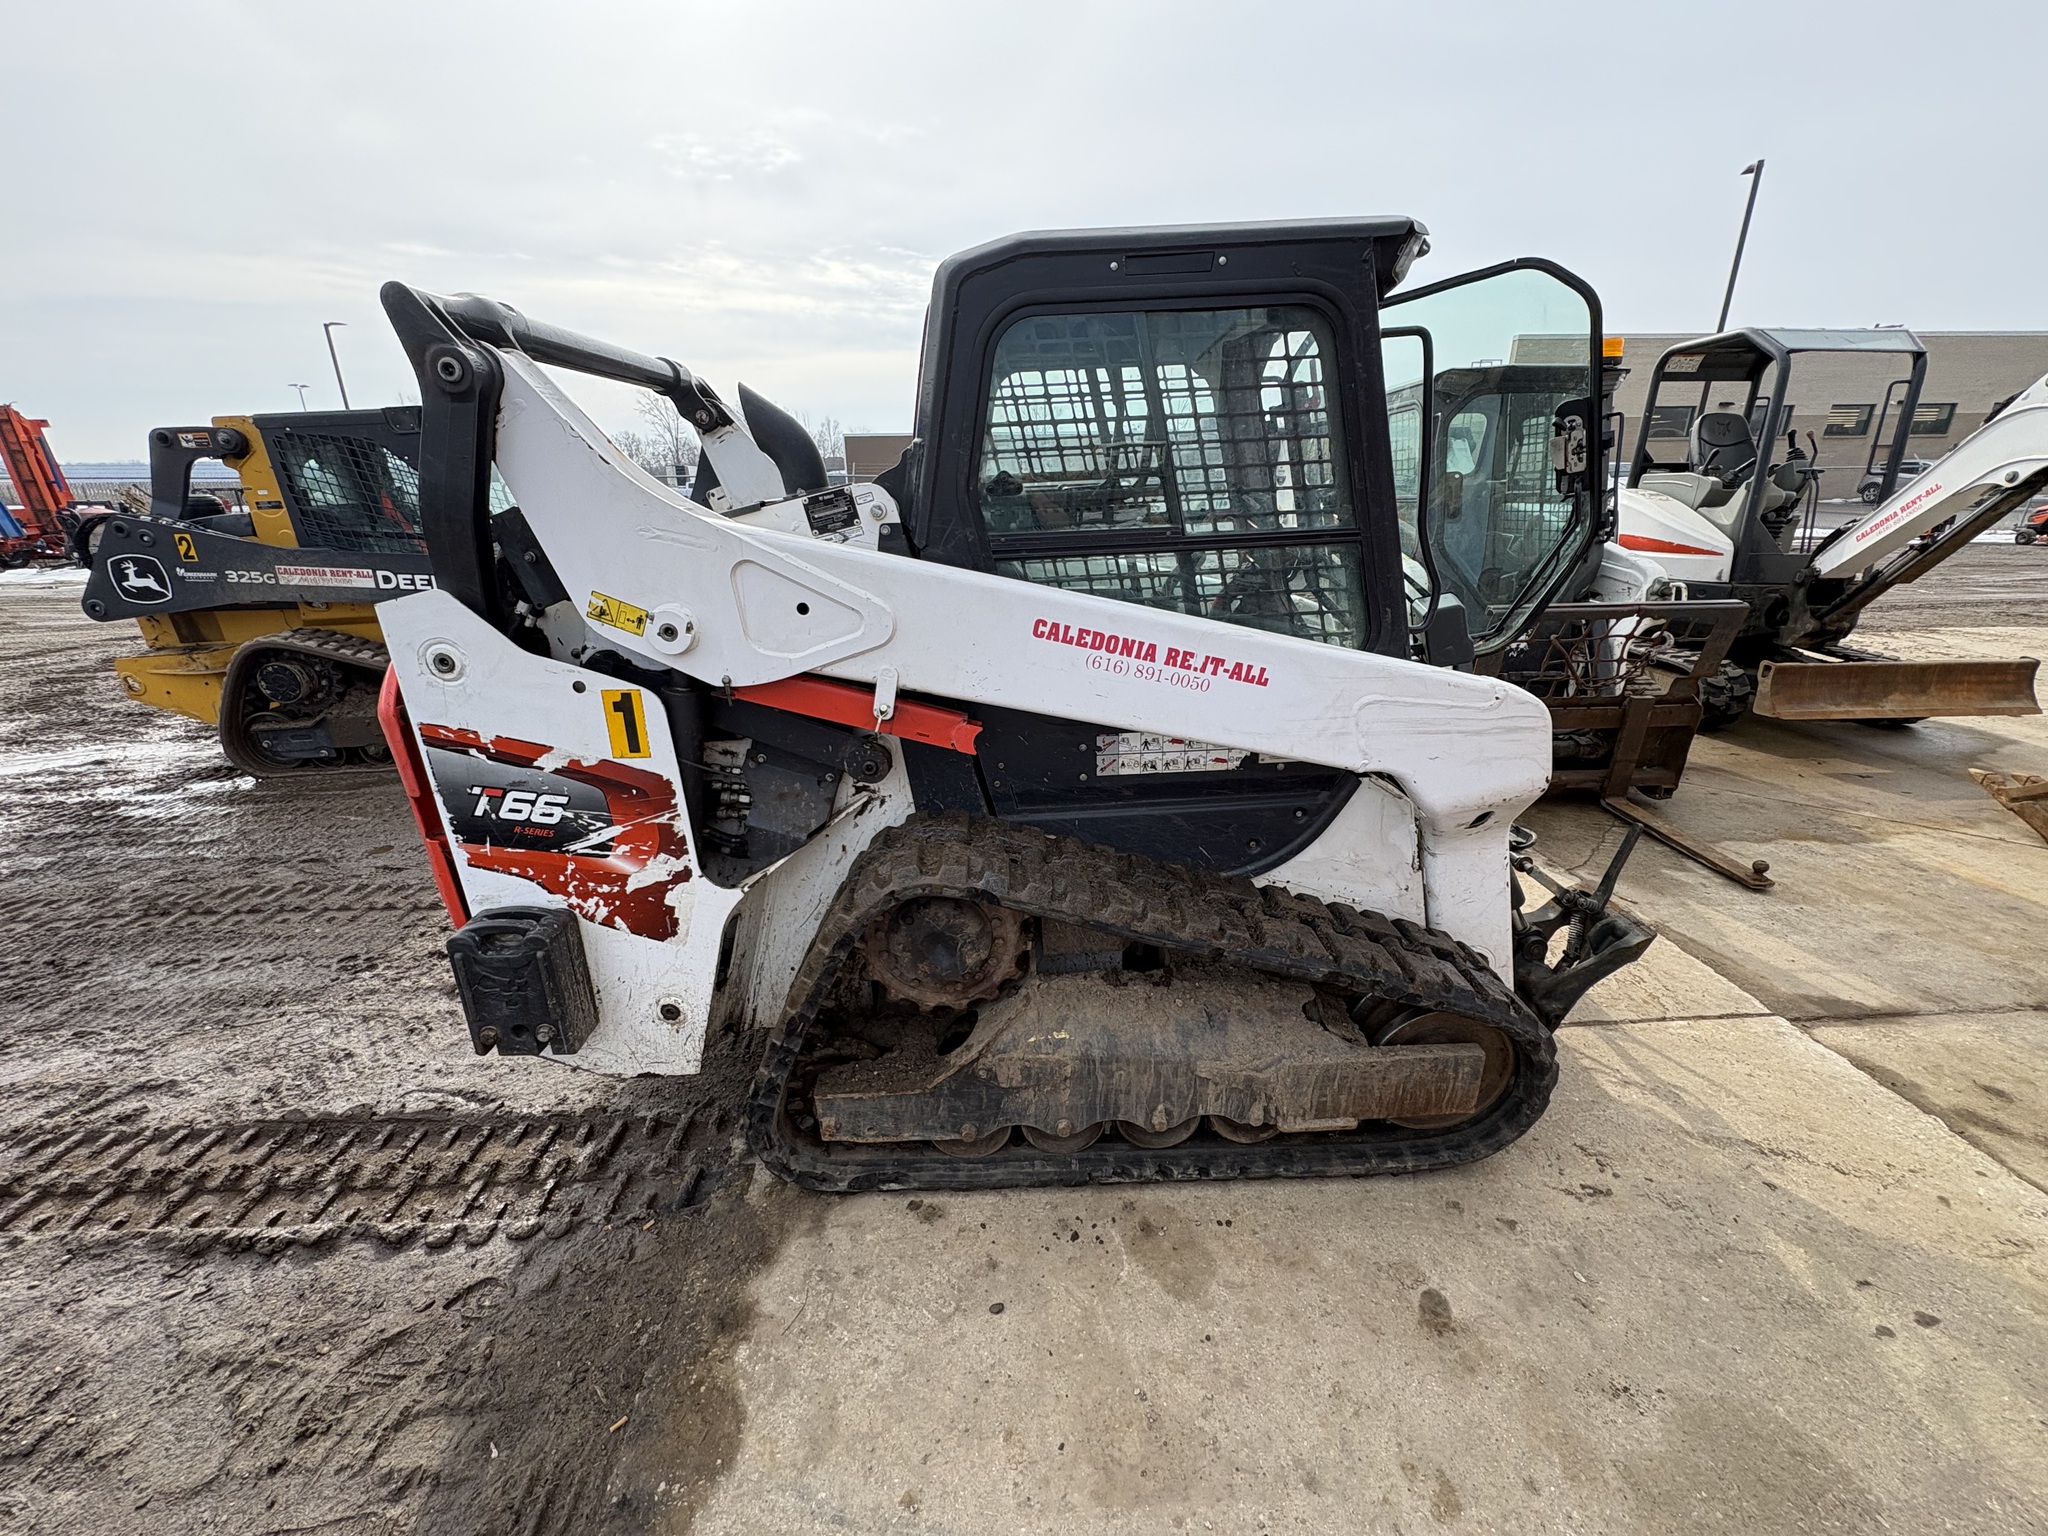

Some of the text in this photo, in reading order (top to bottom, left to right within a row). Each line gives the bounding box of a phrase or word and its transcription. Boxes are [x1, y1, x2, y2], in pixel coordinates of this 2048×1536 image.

[1855, 482, 1943, 542] CALEDONIA RENT-ALL
[177, 535, 196, 560] 2
[224, 570, 276, 584] 325G
[277, 566, 374, 579] CALEDONIA RENT-ALL
[1032, 618, 1158, 663] CALEDONIA
[1085, 653, 1211, 693] (616) 891-0050
[612, 692, 642, 754] 1
[470, 785, 570, 825] T66
[513, 825, 556, 838] R-SERIES
